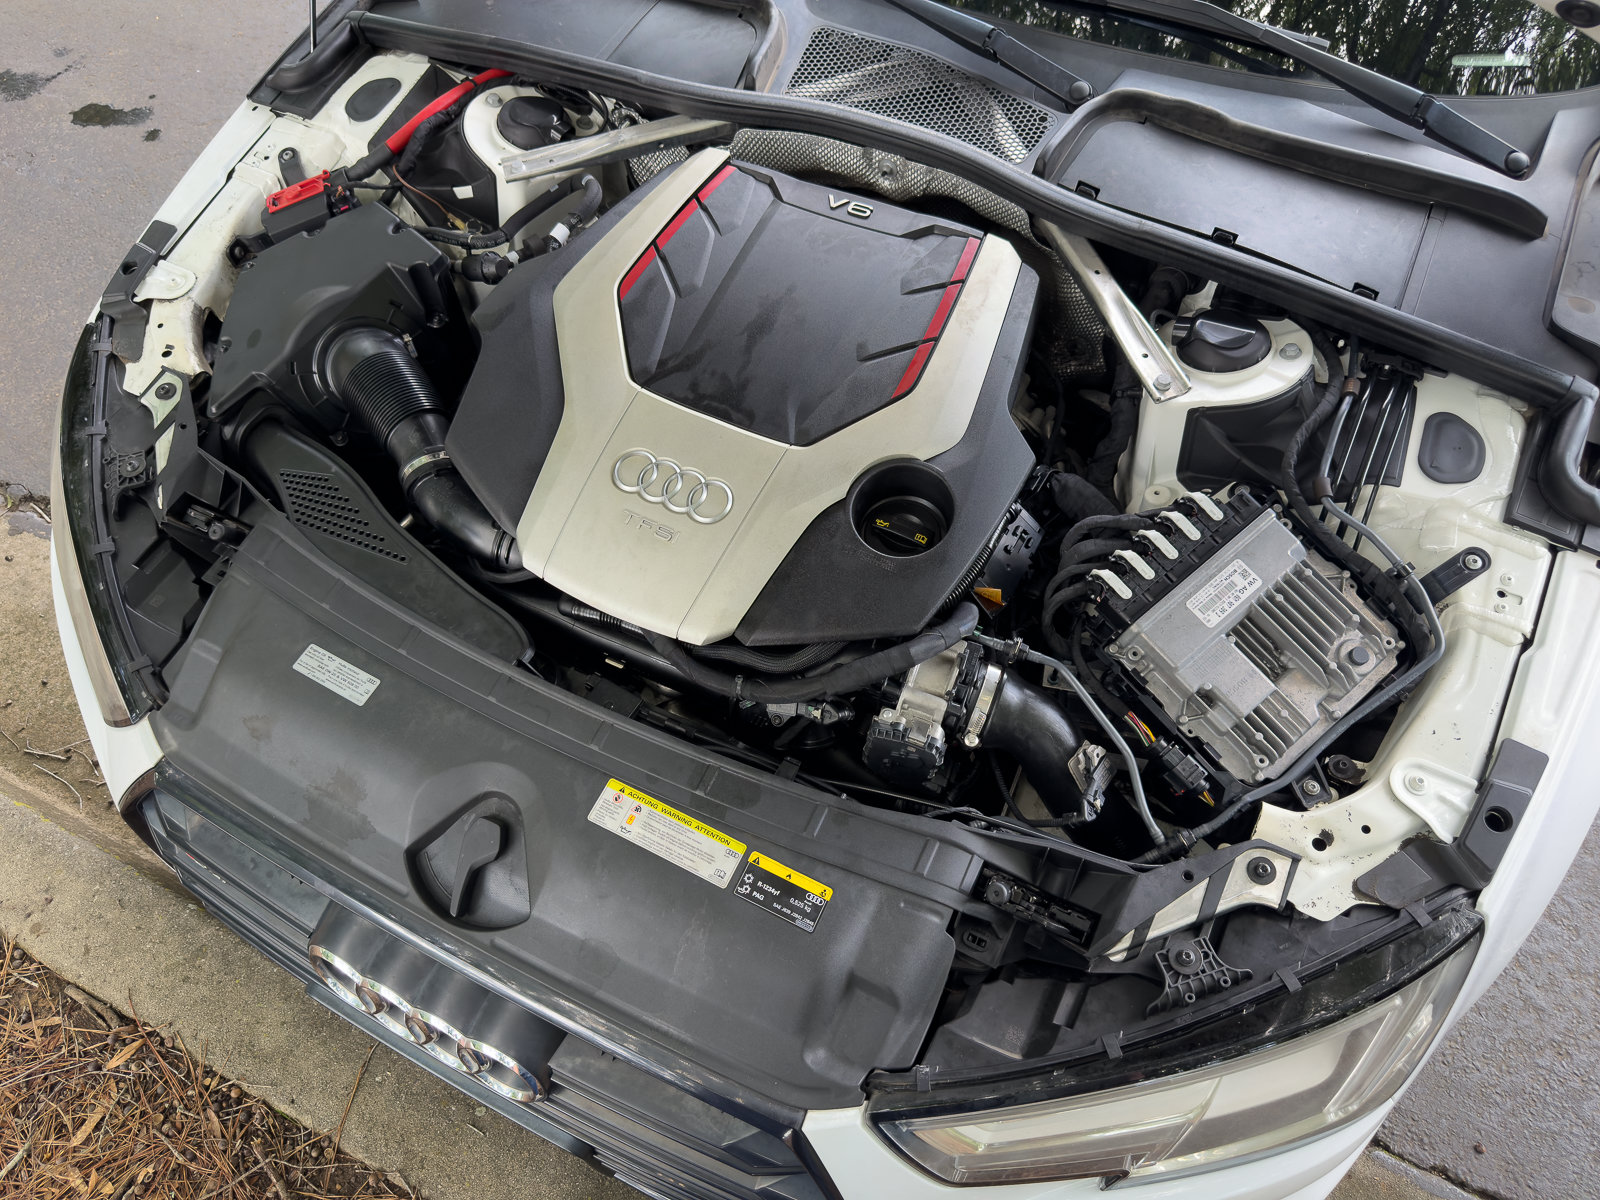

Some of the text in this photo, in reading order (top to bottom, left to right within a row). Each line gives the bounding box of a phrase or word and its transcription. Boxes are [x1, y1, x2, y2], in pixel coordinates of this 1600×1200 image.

[829, 194, 873, 218] V6
[624, 510, 680, 544] TFSI
[1247, 577, 1258, 588] VW
[1238, 585, 1248, 595] AG
[628, 791, 659, 810] ACHTUNG
[661, 807, 693, 827] WARNING
[694, 825, 731, 846] ATTENTION
[757, 880, 780, 896] R-1234yf
[752, 890, 765, 901] PAG
[804, 904, 812, 913] kg
